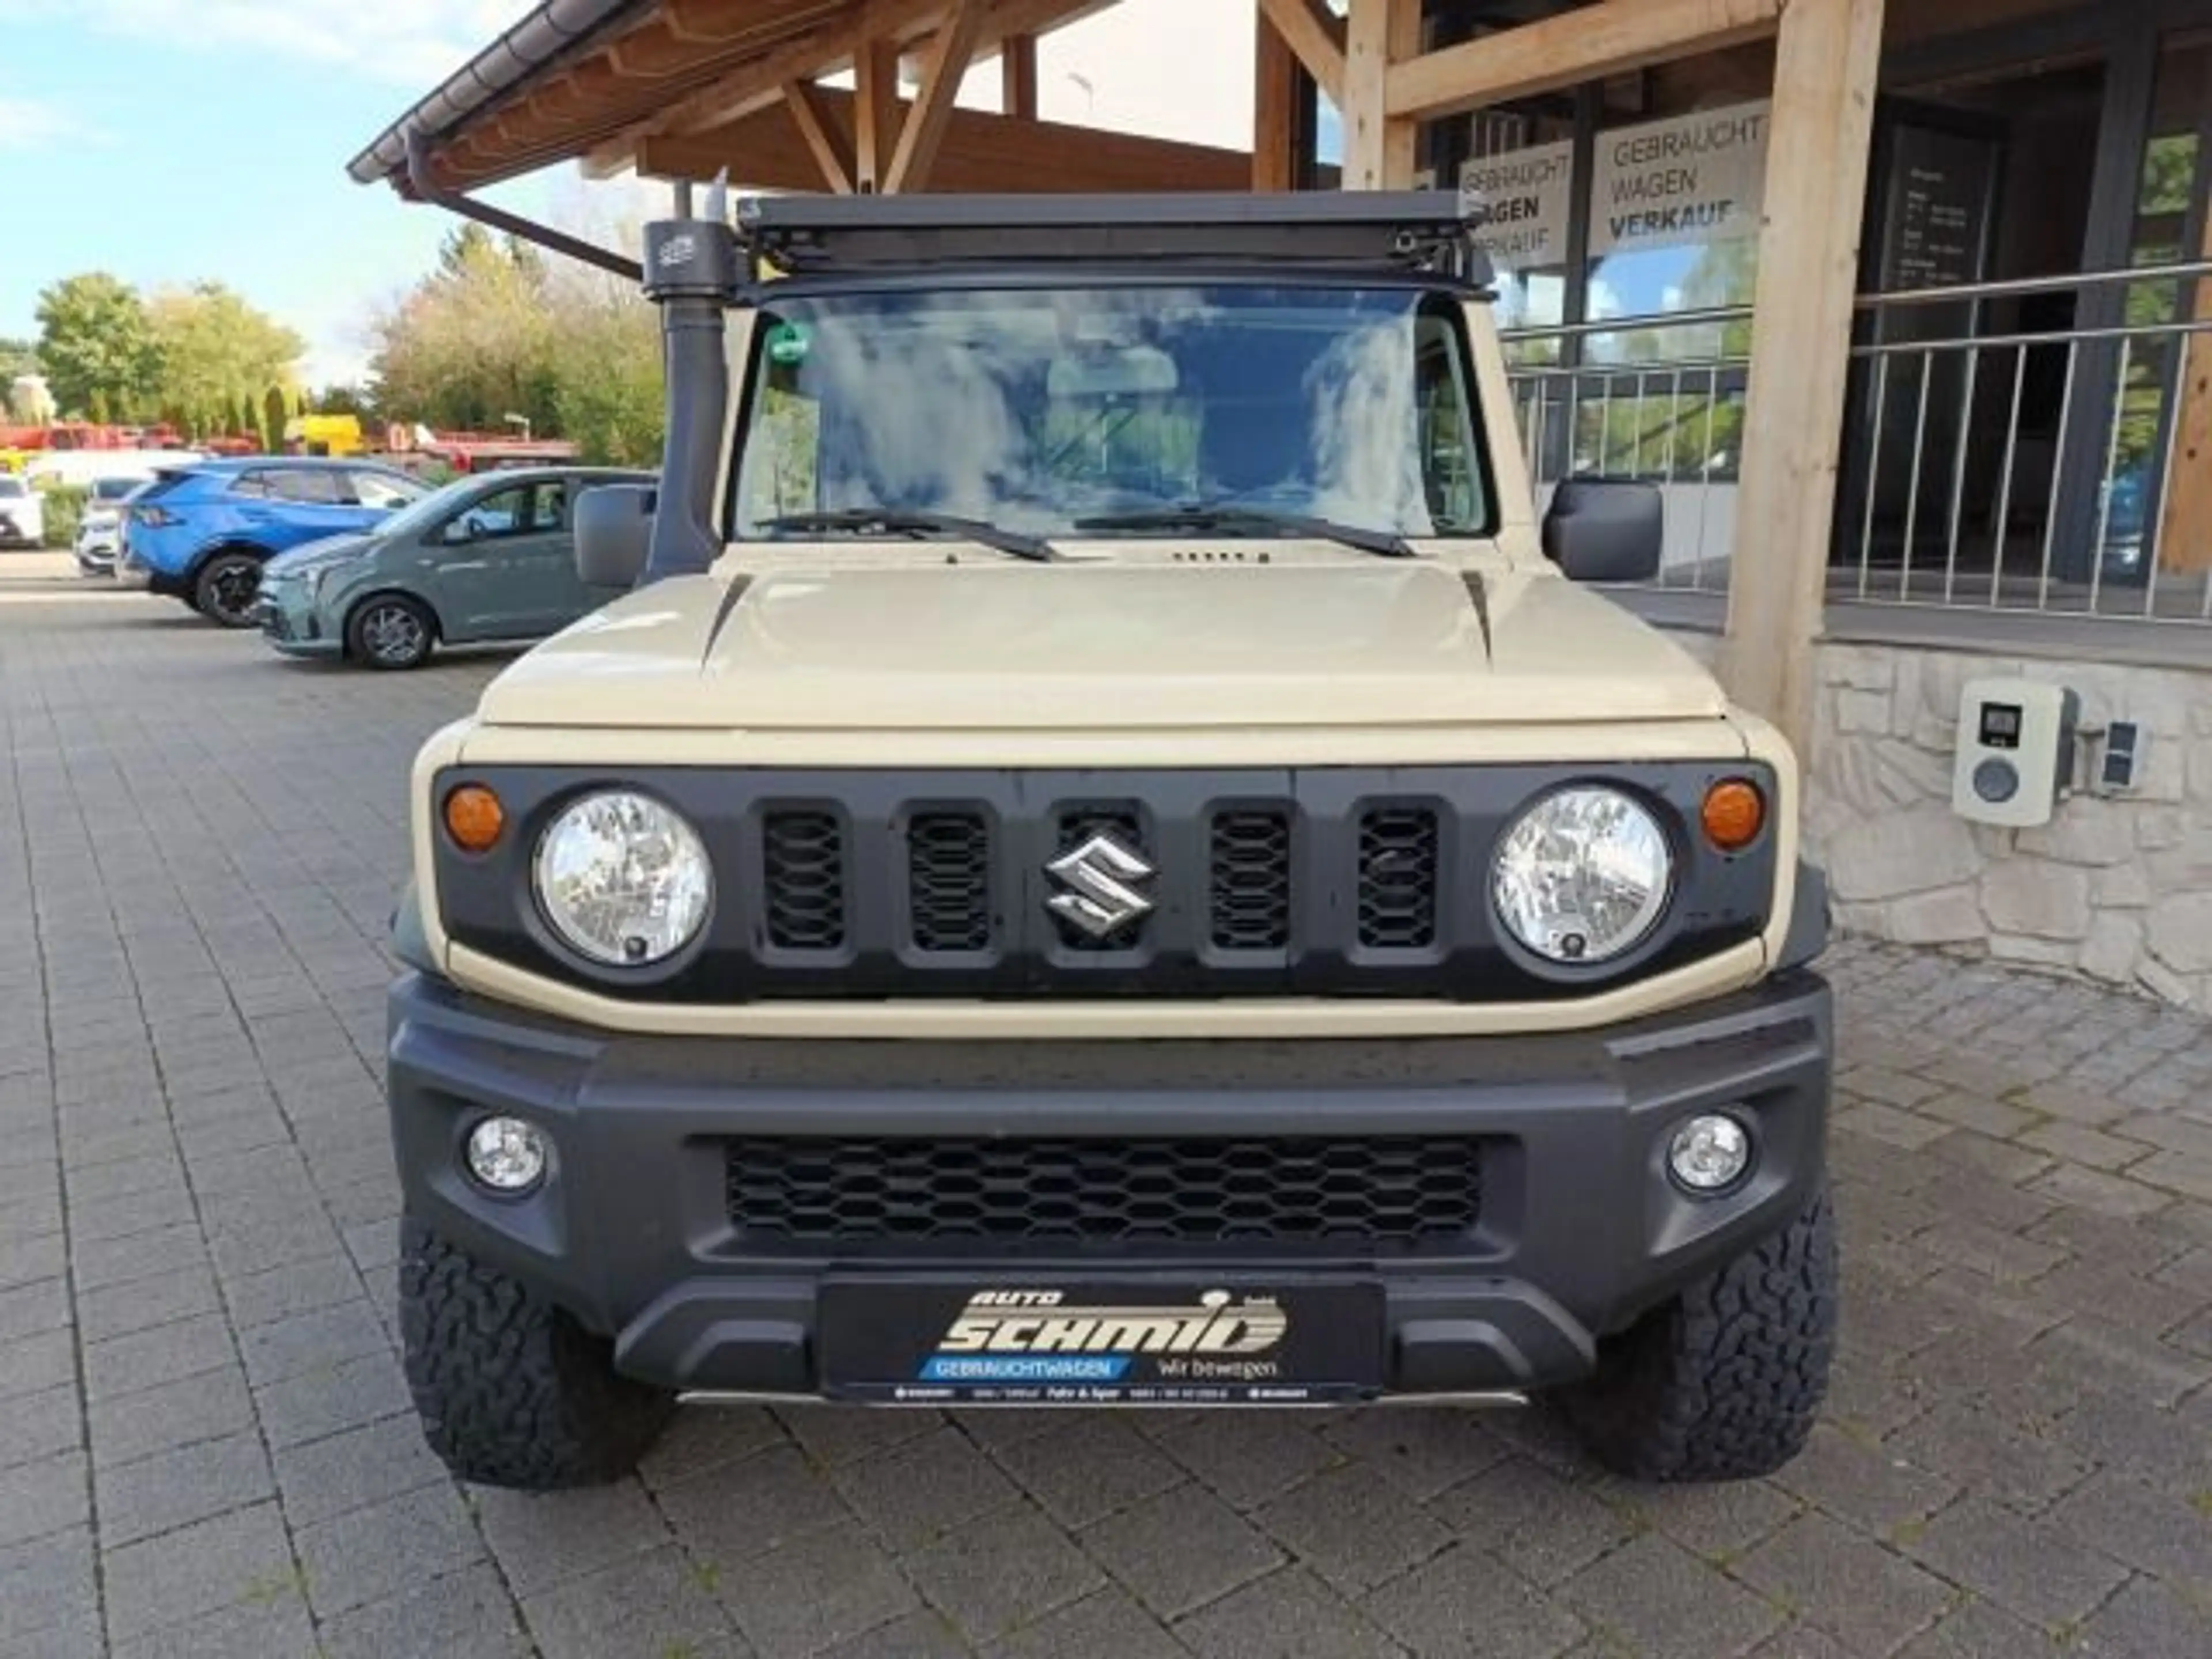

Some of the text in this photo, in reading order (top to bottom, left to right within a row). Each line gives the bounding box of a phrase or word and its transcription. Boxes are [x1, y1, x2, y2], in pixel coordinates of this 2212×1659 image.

[1613, 113, 1764, 167] GEBRAUCHT
[1612, 168, 1698, 204] WAGEN
[1609, 199, 1733, 240] VERKAUF
[969, 1290, 1064, 1306] AUTO
[934, 1359, 1112, 1377] GEBRAUCHTWAGEN
[1157, 1359, 1188, 1377] Wir
